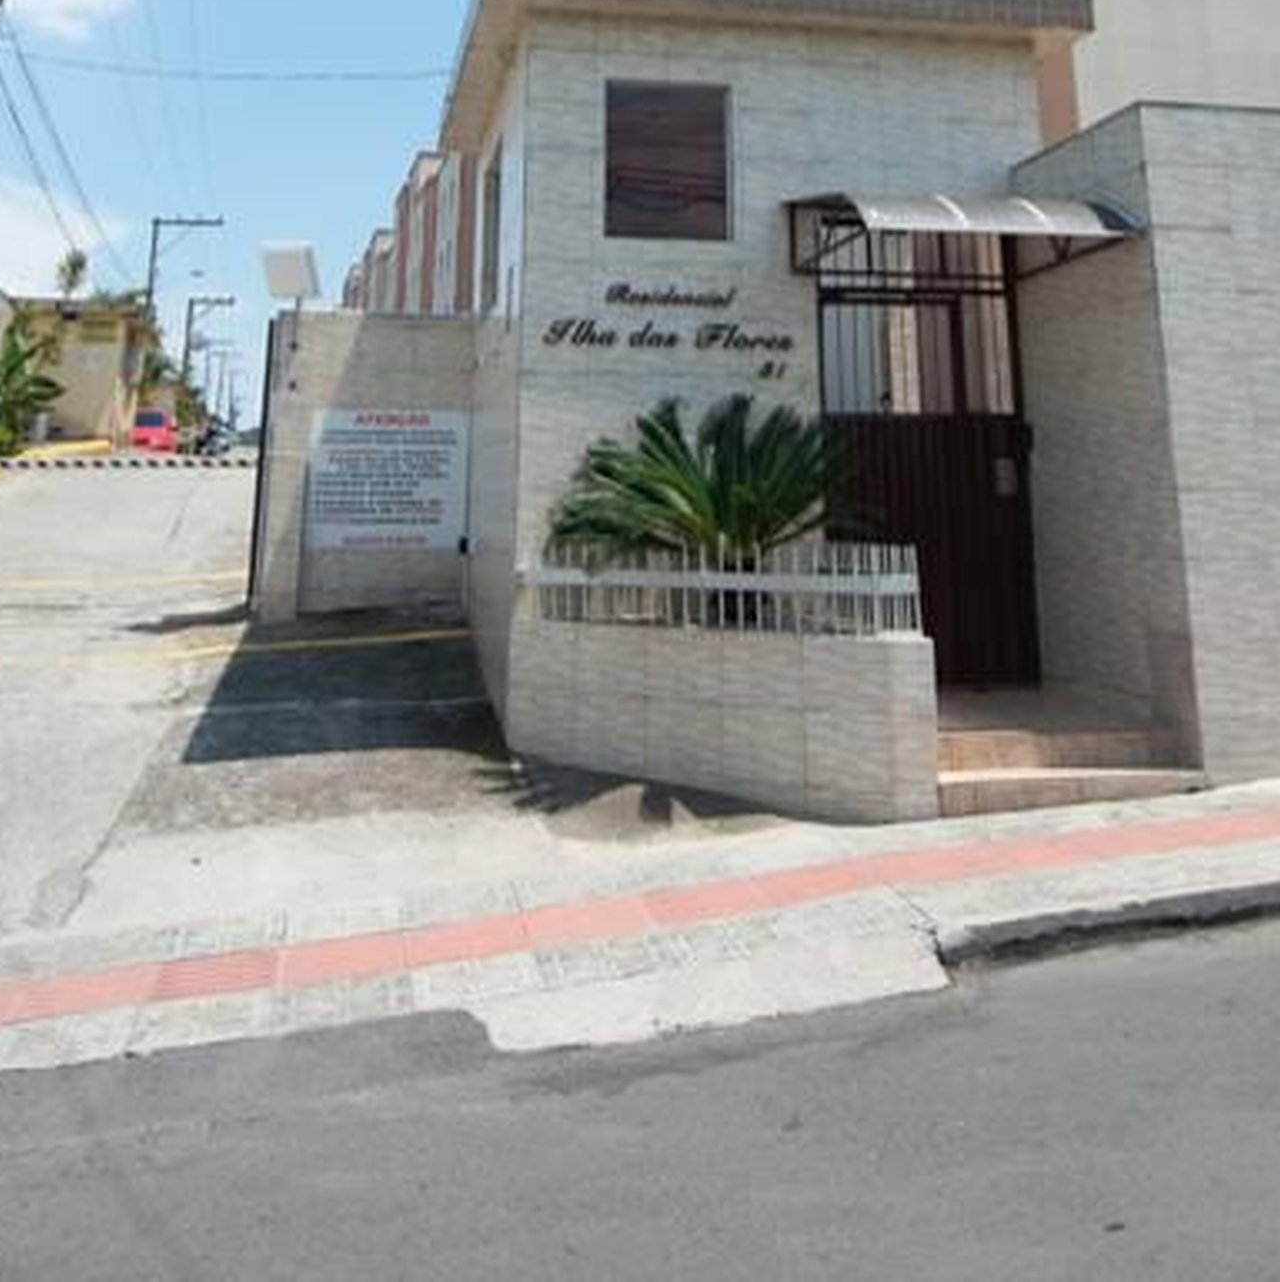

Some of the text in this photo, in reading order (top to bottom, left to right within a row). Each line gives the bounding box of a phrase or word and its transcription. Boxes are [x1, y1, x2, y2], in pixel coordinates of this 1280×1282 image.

[604, 282, 737, 308] Residencial
[542, 320, 794, 351] Ilha das Flores
